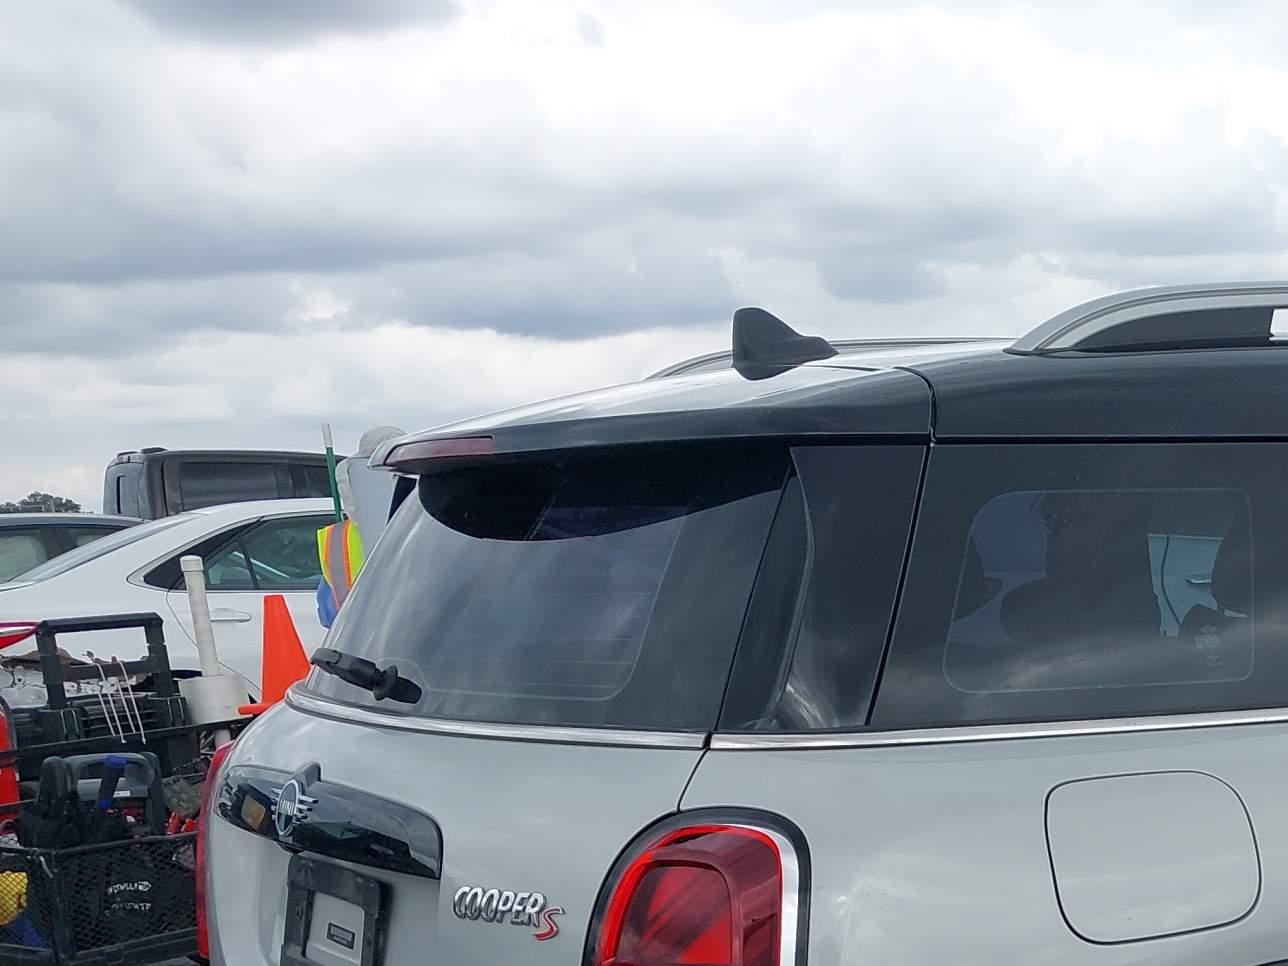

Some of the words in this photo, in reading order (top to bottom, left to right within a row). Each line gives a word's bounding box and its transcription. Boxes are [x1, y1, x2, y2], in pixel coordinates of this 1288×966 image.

[279, 799, 295, 816] MINI
[453, 886, 546, 928] COOPER
[531, 906, 566, 942] S
